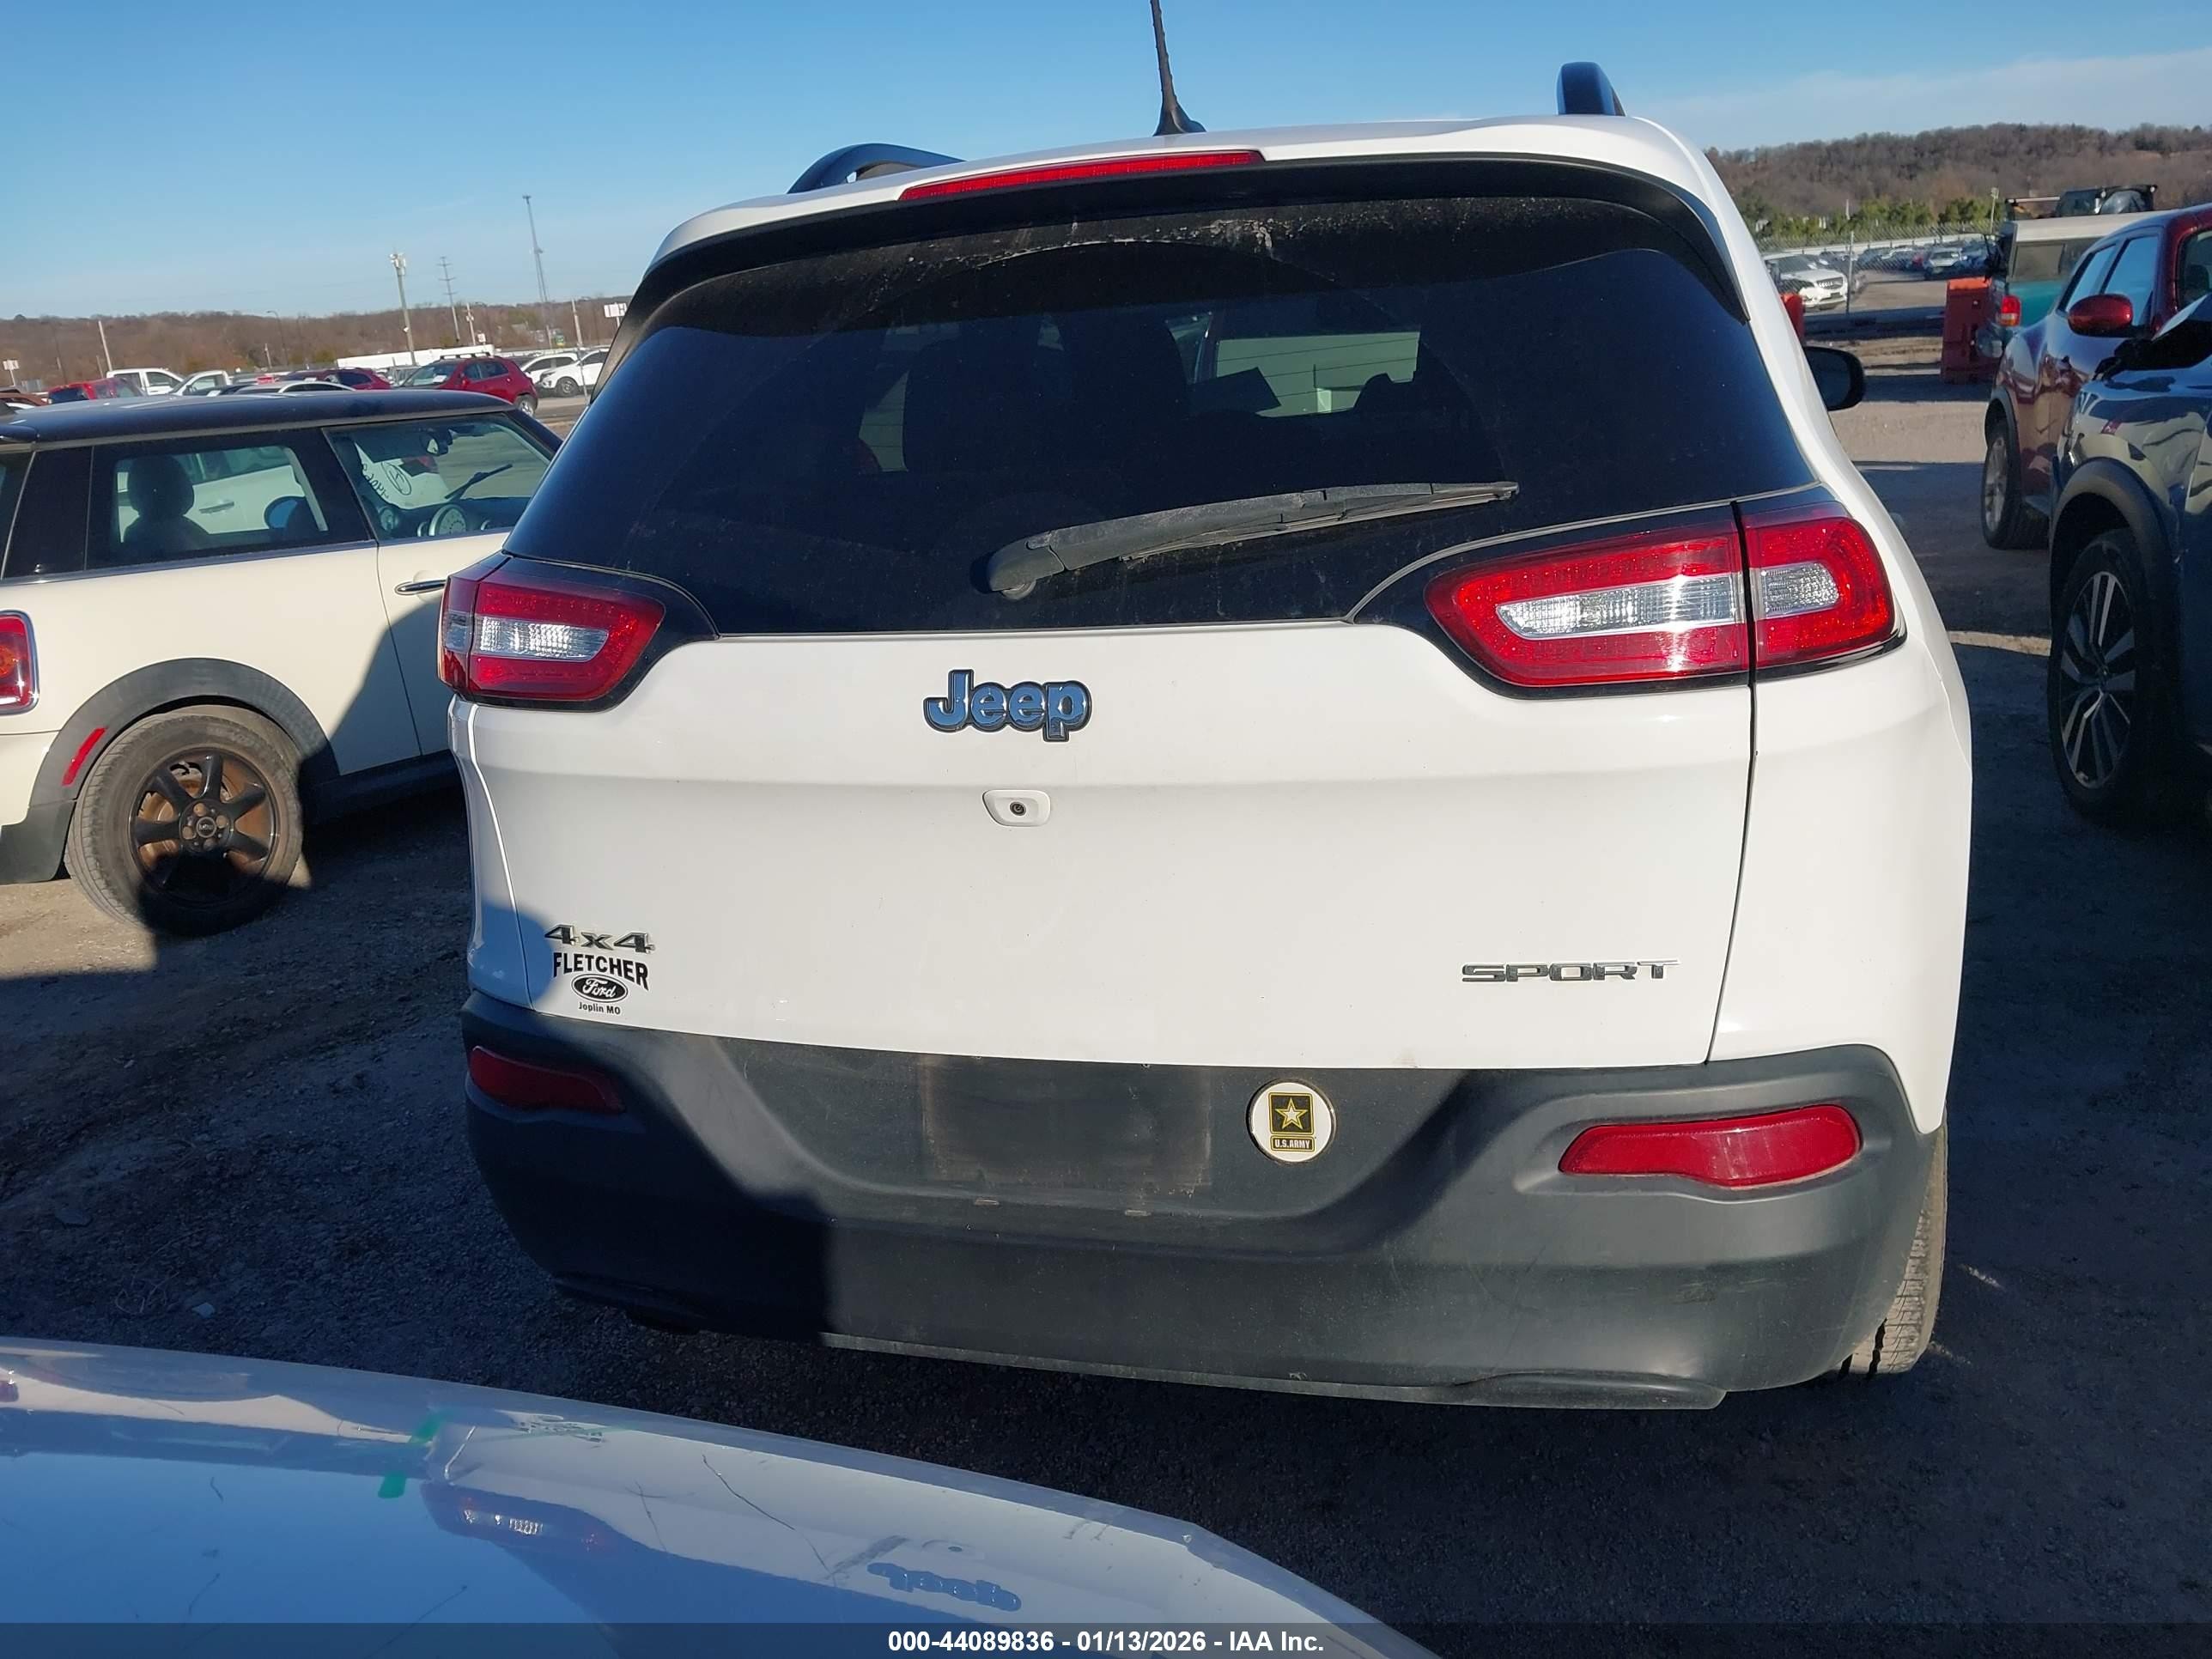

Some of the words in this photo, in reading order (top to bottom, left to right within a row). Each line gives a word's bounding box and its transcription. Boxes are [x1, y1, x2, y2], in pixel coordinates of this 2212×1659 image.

[923, 669, 1092, 742] Jeep
[544, 924, 655, 954] 4x4
[553, 952, 649, 991] FLETCHER
[1462, 959, 1679, 981] SPORT
[582, 977, 617, 998] Ford
[578, 1001, 604, 1013] Joplin
[605, 1006, 621, 1015] MO
